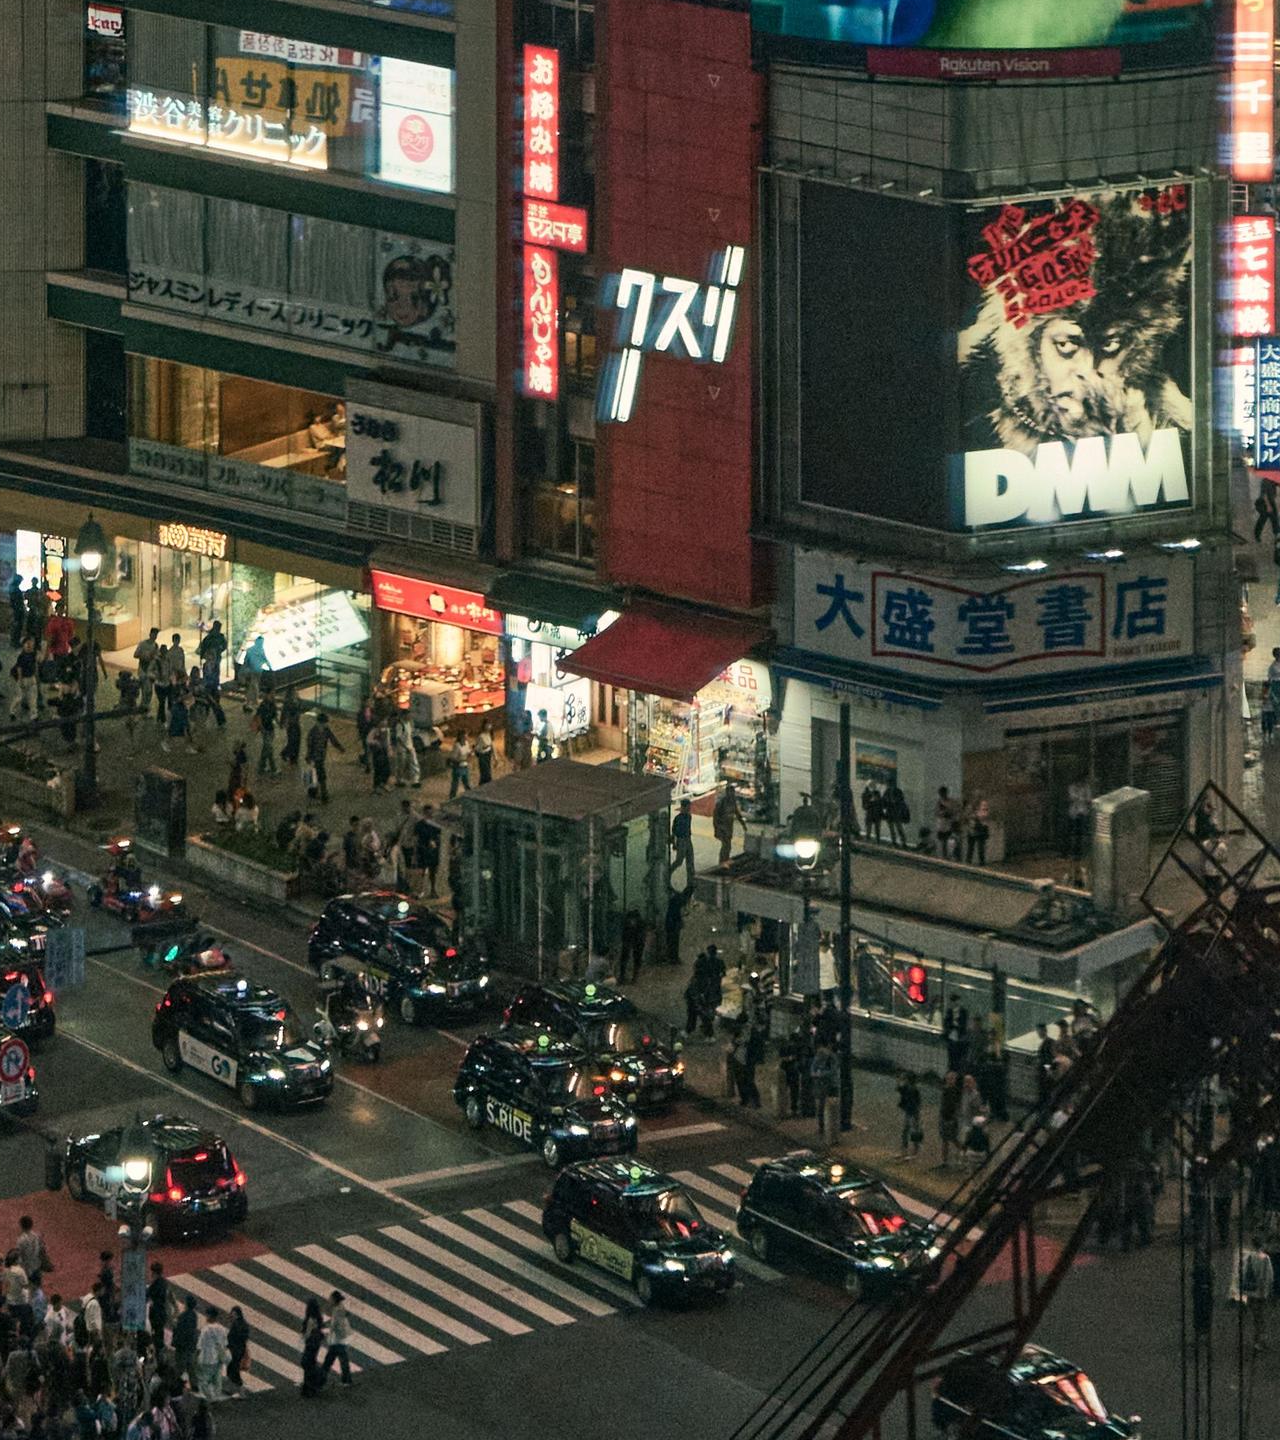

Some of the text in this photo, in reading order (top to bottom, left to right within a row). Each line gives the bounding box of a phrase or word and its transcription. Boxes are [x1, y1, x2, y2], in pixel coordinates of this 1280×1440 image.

[939, 56, 1050, 75] Rakuten Vision
[530, 54, 554, 194] お好み焼
[529, 252, 554, 395] もんじゃ焼
[964, 428, 1190, 525] DMM
[815, 573, 1168, 655] 大盛堂書店
